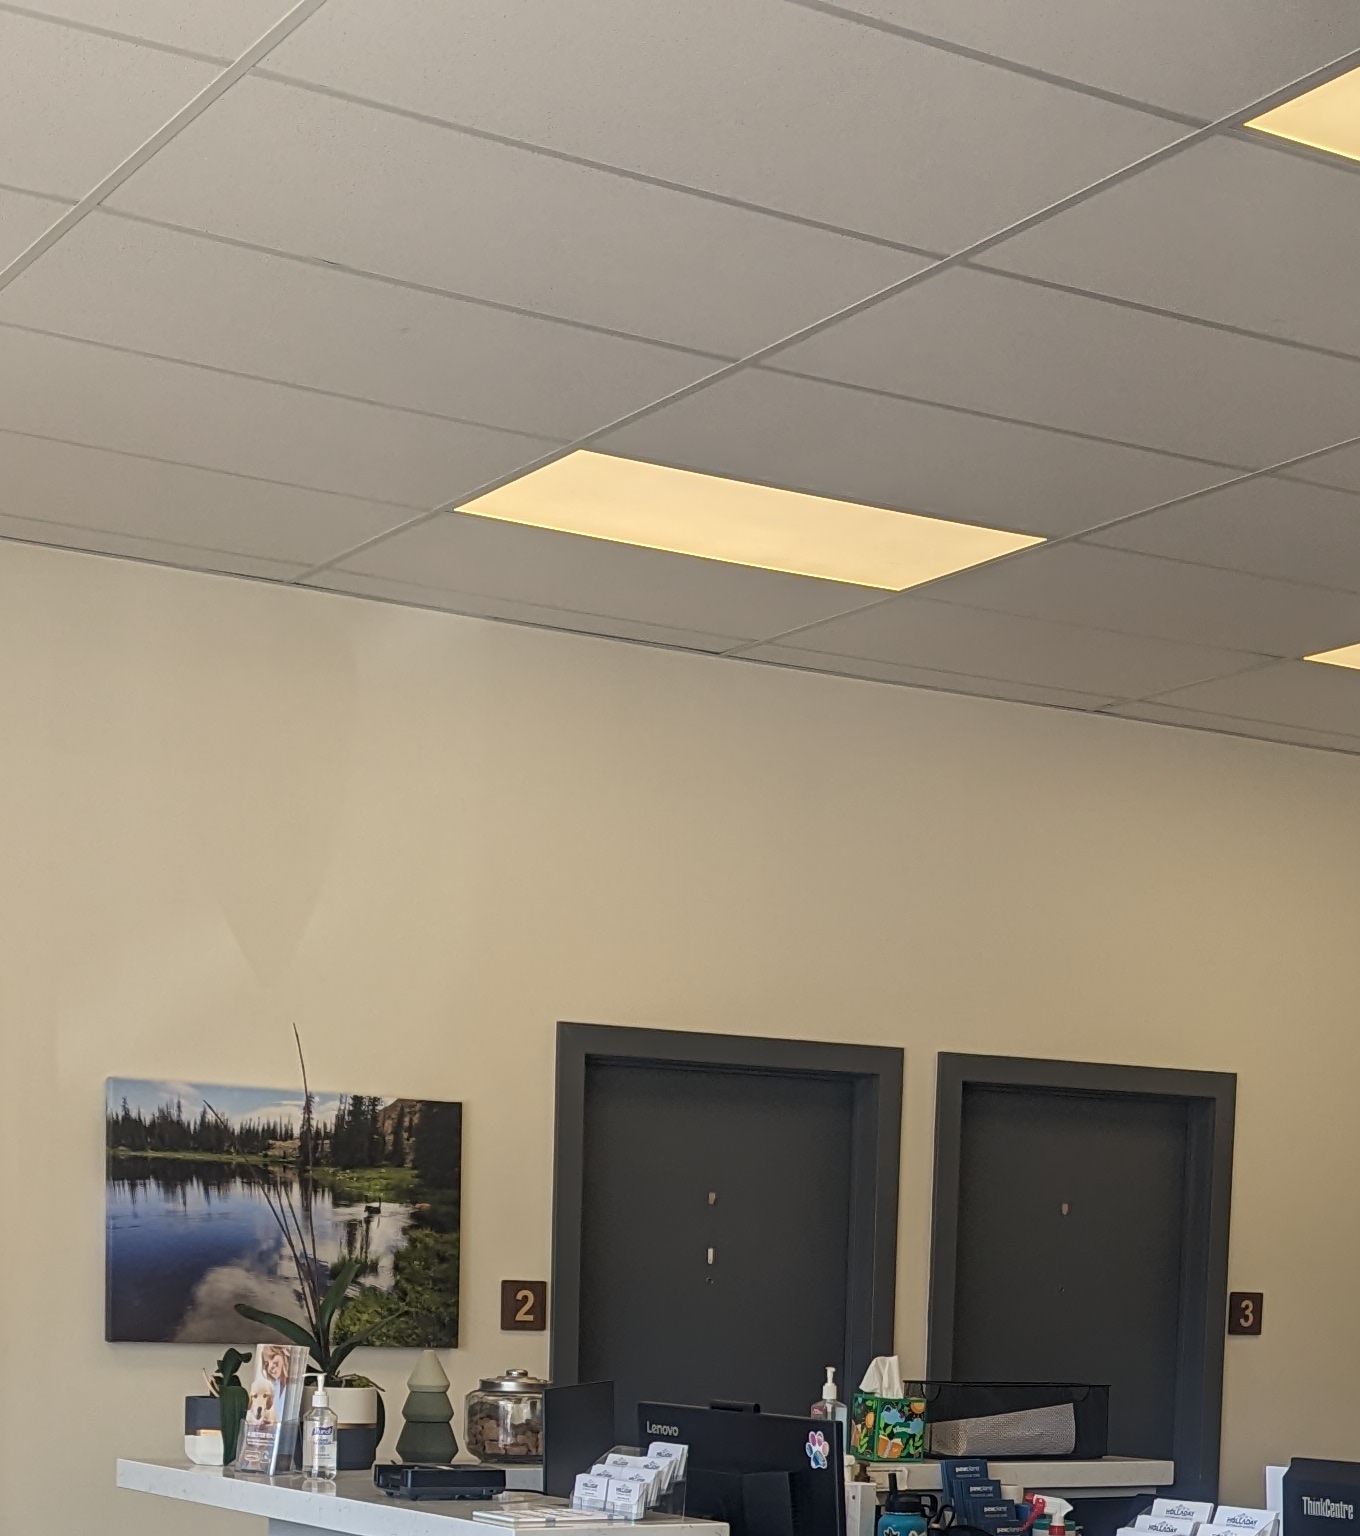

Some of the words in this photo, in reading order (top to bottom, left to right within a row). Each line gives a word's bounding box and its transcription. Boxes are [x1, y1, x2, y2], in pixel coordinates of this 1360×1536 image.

[514, 1289, 535, 1322] 2
[1239, 1299, 1254, 1328] 3
[646, 1420, 679, 1437] Lenovo
[1301, 1496, 1354, 1520] ThinkCentre
[1227, 1516, 1258, 1525] HOLLADAY
